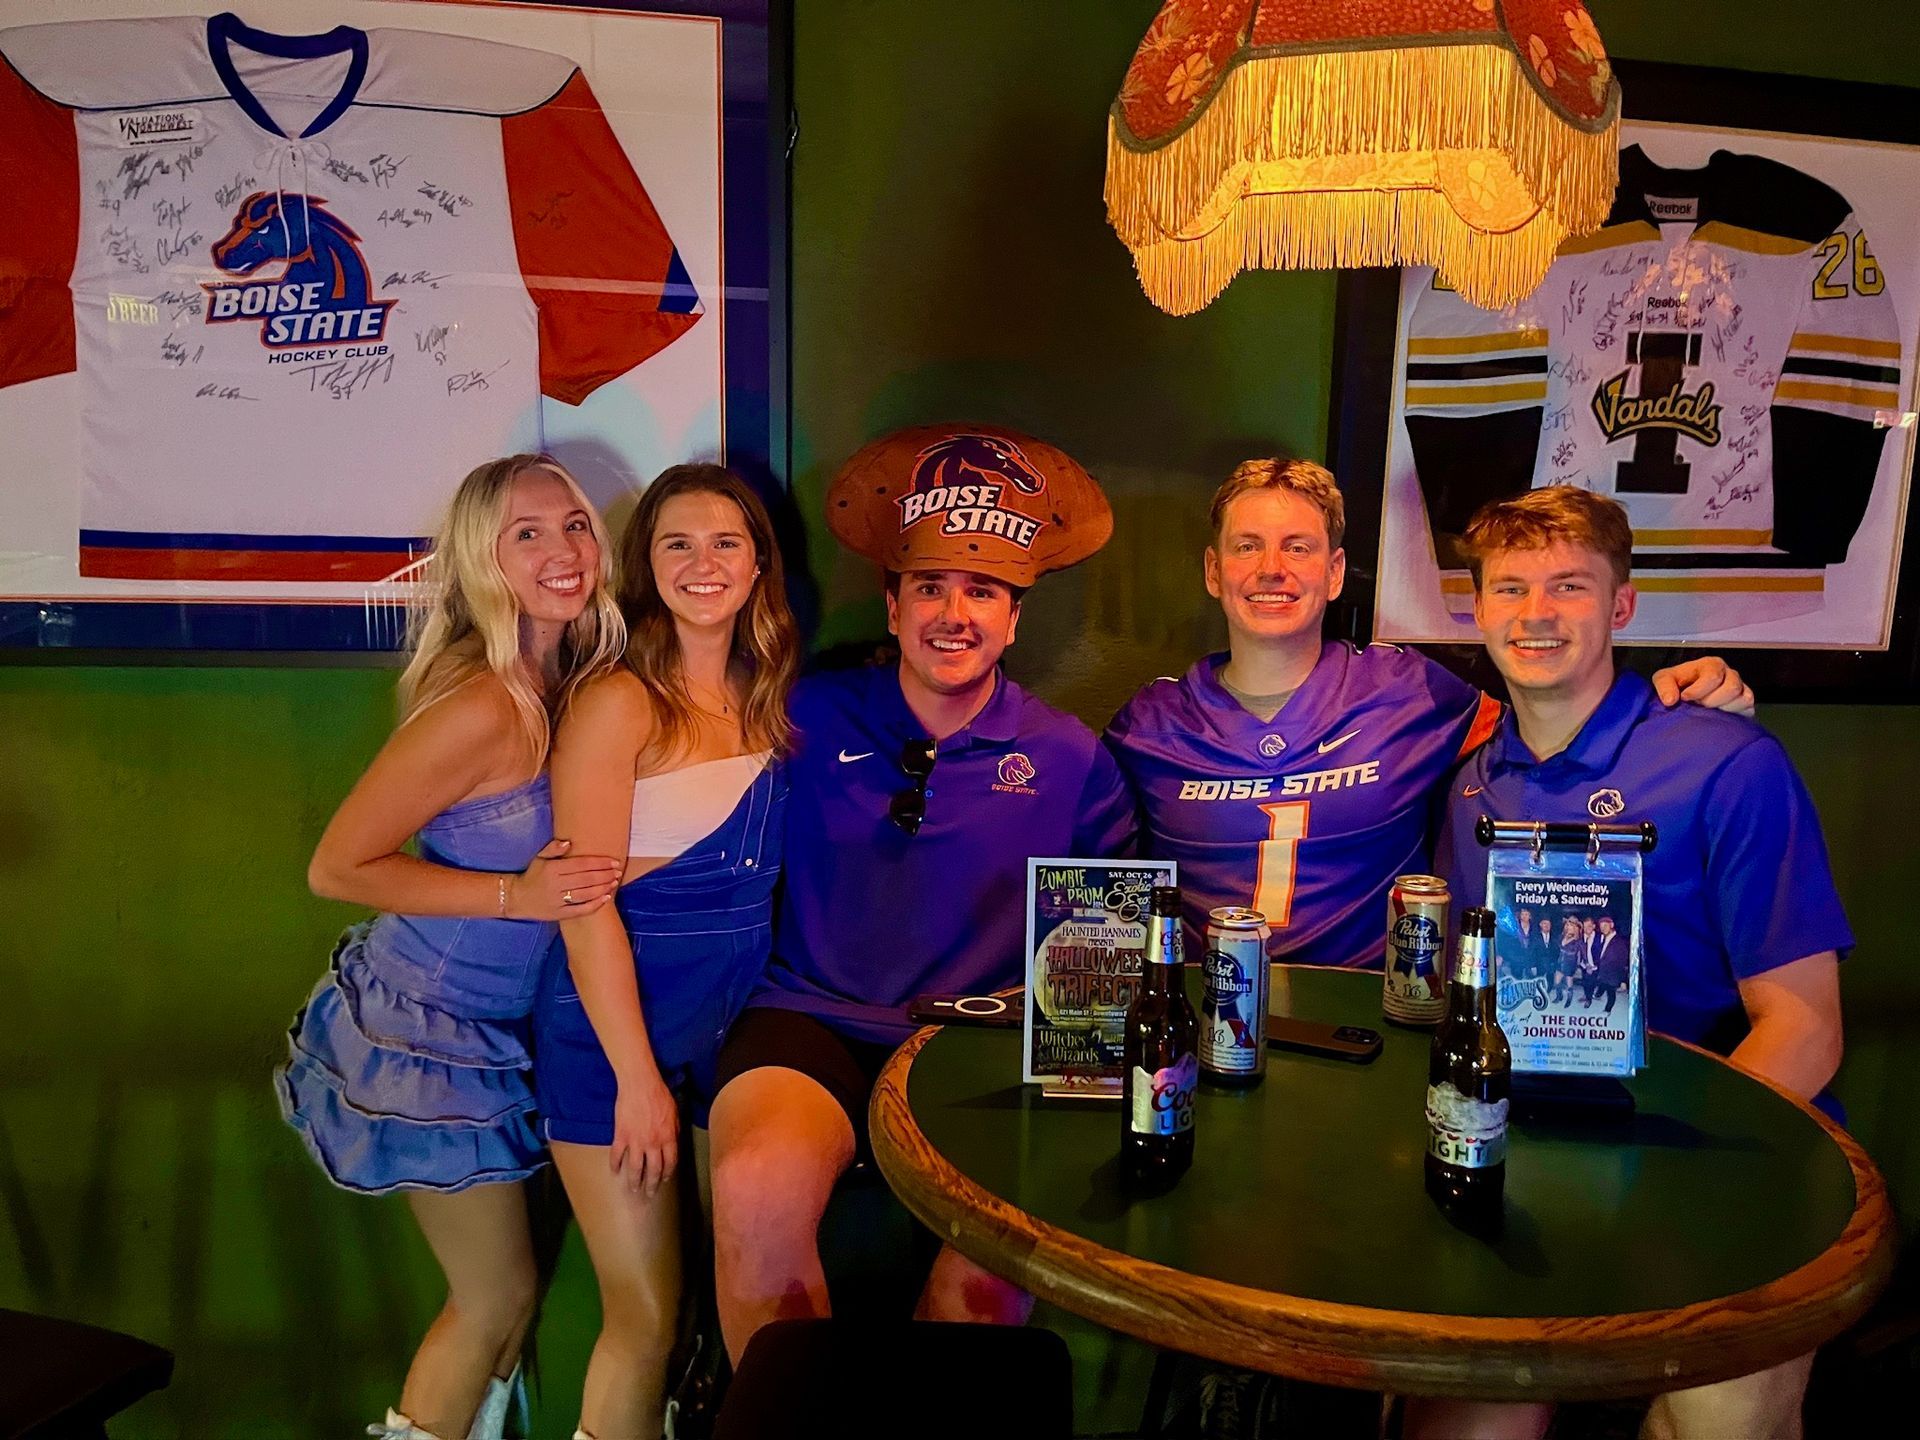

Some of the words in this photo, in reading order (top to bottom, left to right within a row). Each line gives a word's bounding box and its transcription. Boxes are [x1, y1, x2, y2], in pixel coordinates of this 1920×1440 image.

[119, 113, 185, 133] VALUATIONS
[127, 120, 194, 140] NORTHWEST
[1650, 201, 1692, 215] Reebok
[1811, 228, 1886, 301] 26
[213, 282, 325, 317] BOISE
[1647, 296, 1688, 309] Reebok
[268, 307, 383, 343] STATE
[268, 349, 339, 364] HOCKEY
[345, 345, 389, 358] CLUB
[1593, 372, 1721, 441] Vandals
[904, 485, 1001, 525] BOISE
[945, 508, 1037, 546] STATE
[1178, 777, 1274, 801] BOISE
[1281, 760, 1380, 795] STATE
[1253, 800, 1311, 927] 1
[1039, 868, 1087, 891] ZOMBIE
[1143, 872, 1153, 880] 26
[1515, 881, 1545, 894] Every
[1546, 882, 1609, 896] Wednesday,
[1515, 893, 1548, 907] Friday
[1549, 894, 1559, 904] &
[1561, 894, 1609, 908] Saturday
[1062, 926, 1100, 938] HAUNTED
[1400, 919, 1431, 937] Pabst
[1408, 937, 1443, 951] Ribbon
[1047, 945, 1144, 974] HALLOWEE
[1205, 955, 1235, 978] Pabst
[1048, 974, 1142, 1007] TRIFECT
[1211, 976, 1251, 992] Ribbon
[1541, 1015, 1565, 1026] THE
[1568, 1016, 1608, 1028] ROCCI
[1040, 1030, 1086, 1048] Witches
[1523, 1027, 1586, 1040] JOHNSON
[1589, 1029, 1626, 1041] BAND
[1052, 1047, 1099, 1062] Wizards
[1151, 1082, 1195, 1113] Coo
[1161, 1112, 1196, 1131] LIG
[1432, 1136, 1486, 1163] IGHT
